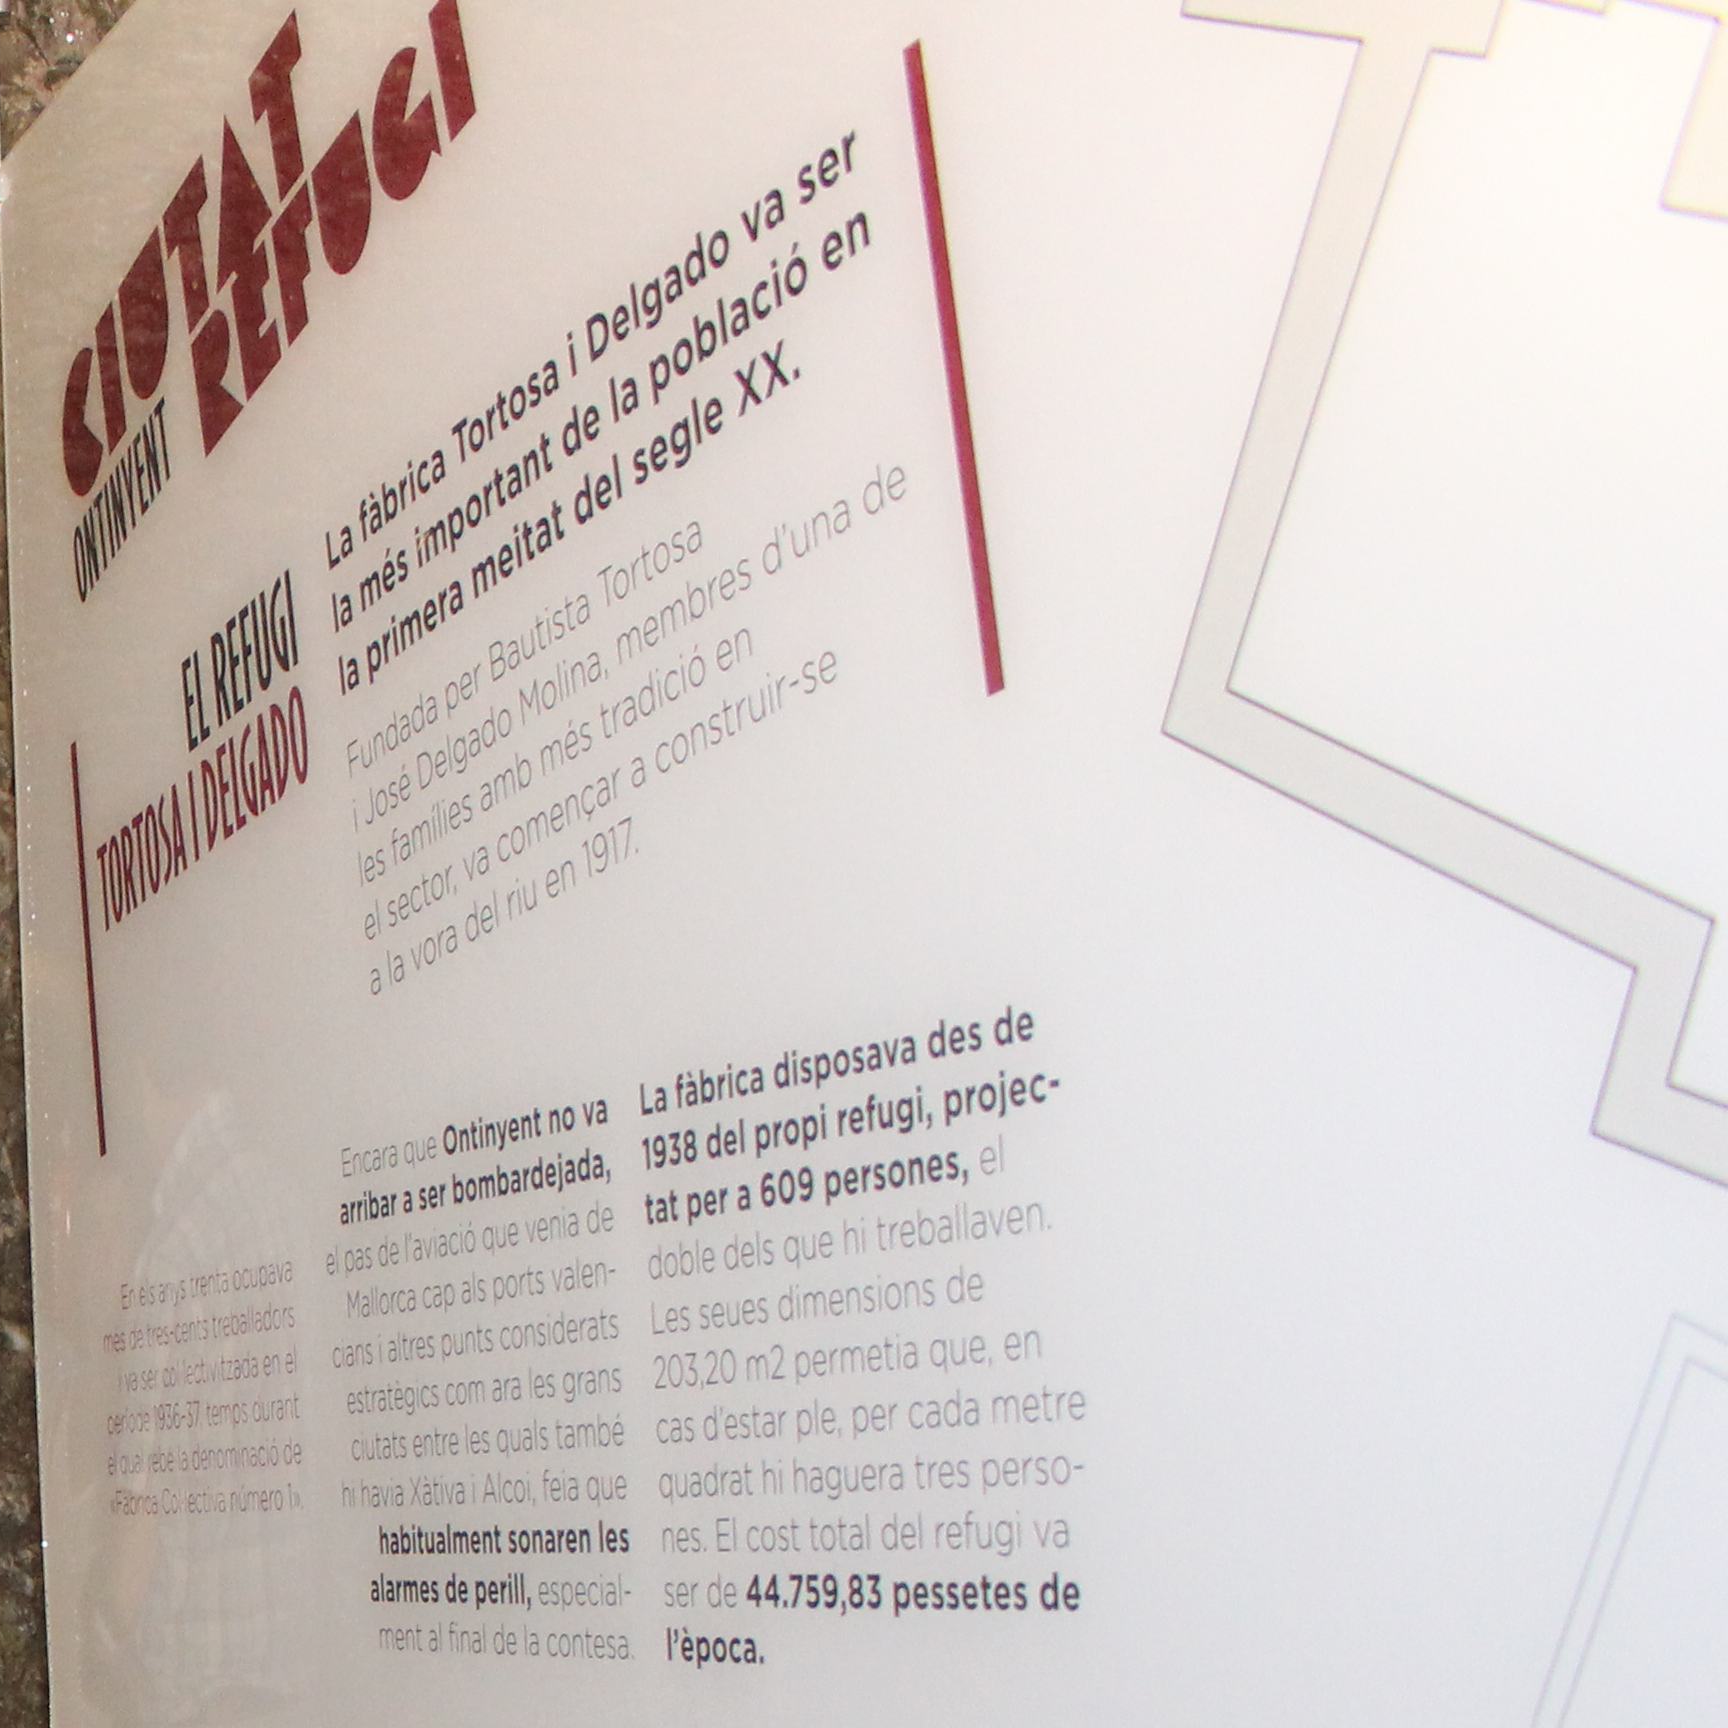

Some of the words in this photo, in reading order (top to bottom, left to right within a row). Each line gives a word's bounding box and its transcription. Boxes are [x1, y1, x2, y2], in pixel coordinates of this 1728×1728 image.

[62, 9, 304, 497] CIUTAT
[190, 0, 477, 458] REFUGI
[326, 525, 353, 570] La
[359, 450, 446, 542] fàbrica
[451, 360, 559, 463] Tortosa
[567, 331, 577, 377] i
[586, 230, 730, 362] Delgado
[741, 188, 785, 242] va
[798, 130, 856, 205] ser
[332, 593, 353, 633] la
[360, 548, 408, 612] més
[415, 433, 553, 568] important
[562, 405, 600, 457] de
[609, 377, 639, 423] la
[649, 242, 808, 405] població
[822, 212, 870, 271] en
[73, 396, 172, 603] ONTINYENT
[338, 656, 360, 695] la
[367, 580, 464, 684] primera
[472, 500, 565, 599] meitat
[574, 453, 622, 525] del
[633, 397, 723, 485] segle
[734, 339, 800, 417] XX.
[181, 650, 210, 753] EL
[210, 569, 299, 728] REFUGI
[346, 693, 438, 778] Fundada
[445, 663, 481, 719] per
[488, 594, 591, 682] Bautista
[597, 521, 703, 607] Tortosa
[352, 799, 360, 833] i
[365, 764, 411, 825] José
[416, 706, 513, 791] Delgado
[519, 652, 609, 726] Molina,
[616, 558, 752, 665] membres
[762, 499, 852, 575] d'una
[862, 464, 907, 516] de
[358, 848, 386, 887] les
[391, 793, 473, 866] famílies
[480, 752, 532, 812] amb
[540, 719, 593, 776] més
[600, 644, 706, 739] tradició
[716, 628, 753, 672] en
[364, 899, 381, 941] el
[387, 864, 457, 928] sector,
[462, 845, 490, 881] va
[497, 767, 621, 863] començar
[631, 756, 647, 789] a
[655, 650, 838, 774] construir-se
[96, 784, 188, 932] TORTOSA
[187, 770, 200, 862] I
[201, 685, 309, 852] DELGADO
[370, 968, 382, 996] a
[386, 950, 405, 986] la
[410, 925, 458, 971] vora
[465, 889, 500, 942] del
[506, 878, 538, 921] riu
[545, 860, 576, 899] en
[581, 815, 639, 878] 1917.
[640, 1083, 667, 1116] La
[675, 1063, 764, 1108] fàbrica
[774, 1036, 917, 1089] disposava
[928, 1019, 982, 1059] des
[994, 1005, 1034, 1046] de
[341, 1144, 398, 1178] Encara
[403, 1136, 437, 1169] que
[443, 1108, 542, 1155] Ontinyent
[549, 1106, 575, 1134] no
[582, 1099, 608, 1127] va
[642, 1129, 698, 1170] 1938
[706, 1118, 745, 1159] del
[755, 1103, 827, 1158] propi
[837, 1085, 933, 1137] refugi,
[944, 1070, 1060, 1127] projec-
[340, 1190, 397, 1225] arribar
[403, 1190, 413, 1213] a
[419, 1184, 446, 1211] ser
[452, 1147, 611, 1204] bombardejada,
[645, 1190, 679, 1225] tat
[687, 1187, 728, 1226] per
[737, 1184, 751, 1211] a
[760, 1166, 814, 1208] 609
[824, 1151, 968, 1206] persones,
[979, 1133, 1005, 1176] el
[347, 1286, 417, 1319] Mallorca
[422, 1283, 455, 1313] cap
[461, 1272, 487, 1305] als
[493, 1266, 545, 1306] ports
[551, 1257, 616, 1292] valen-
[648, 1239, 716, 1280] doble
[723, 1231, 775, 1271] dels
[783, 1231, 834, 1269] que
[843, 1217, 866, 1255] hi
[876, 1202, 1052, 1251] treballaven.
[651, 1302, 691, 1335] Les
[699, 1297, 769, 1330] seues
[778, 1275, 936, 1322] dimensions
[946, 1265, 985, 1305] de
[653, 1348, 737, 1390] 203,20
[746, 1343, 786, 1381] m2
[795, 1333, 919, 1385] permetia
[929, 1335, 993, 1374] que,
[1004, 1329, 1042, 1362] en
[656, 1416, 696, 1444] cas
[703, 1405, 787, 1441] d'estar
[796, 1398, 842, 1443] ple,
[852, 1403, 898, 1440] per
[908, 1388, 980, 1430] cada
[992, 1385, 1087, 1424] metre
[658, 1462, 754, 1505] quadrat
[761, 1459, 783, 1495] hi
[793, 1457, 905, 1501] haguera
[914, 1455, 971, 1490] tres
[982, 1455, 1085, 1495] perso-
[379, 1523, 502, 1555] habitualment
[508, 1529, 591, 1554] sonaren
[599, 1520, 630, 1553] les
[662, 1527, 707, 1554] nes.
[715, 1517, 737, 1552] El
[746, 1518, 801, 1553] cost
[809, 1513, 871, 1553] total
[881, 1512, 923, 1551] del
[935, 1510, 1022, 1558] refugi
[1033, 1519, 1071, 1550] va
[371, 1573, 439, 1603] alarmes
[445, 1573, 468, 1604] de
[475, 1573, 531, 1611] perill,
[538, 1573, 632, 1611] especial-
[664, 1581, 699, 1608] ser
[707, 1573, 737, 1609] de
[746, 1573, 882, 1616] 44.759,83
[893, 1575, 1028, 1617] pessetes
[1039, 1572, 1080, 1612] de
[667, 1627, 764, 1669] l'època.
